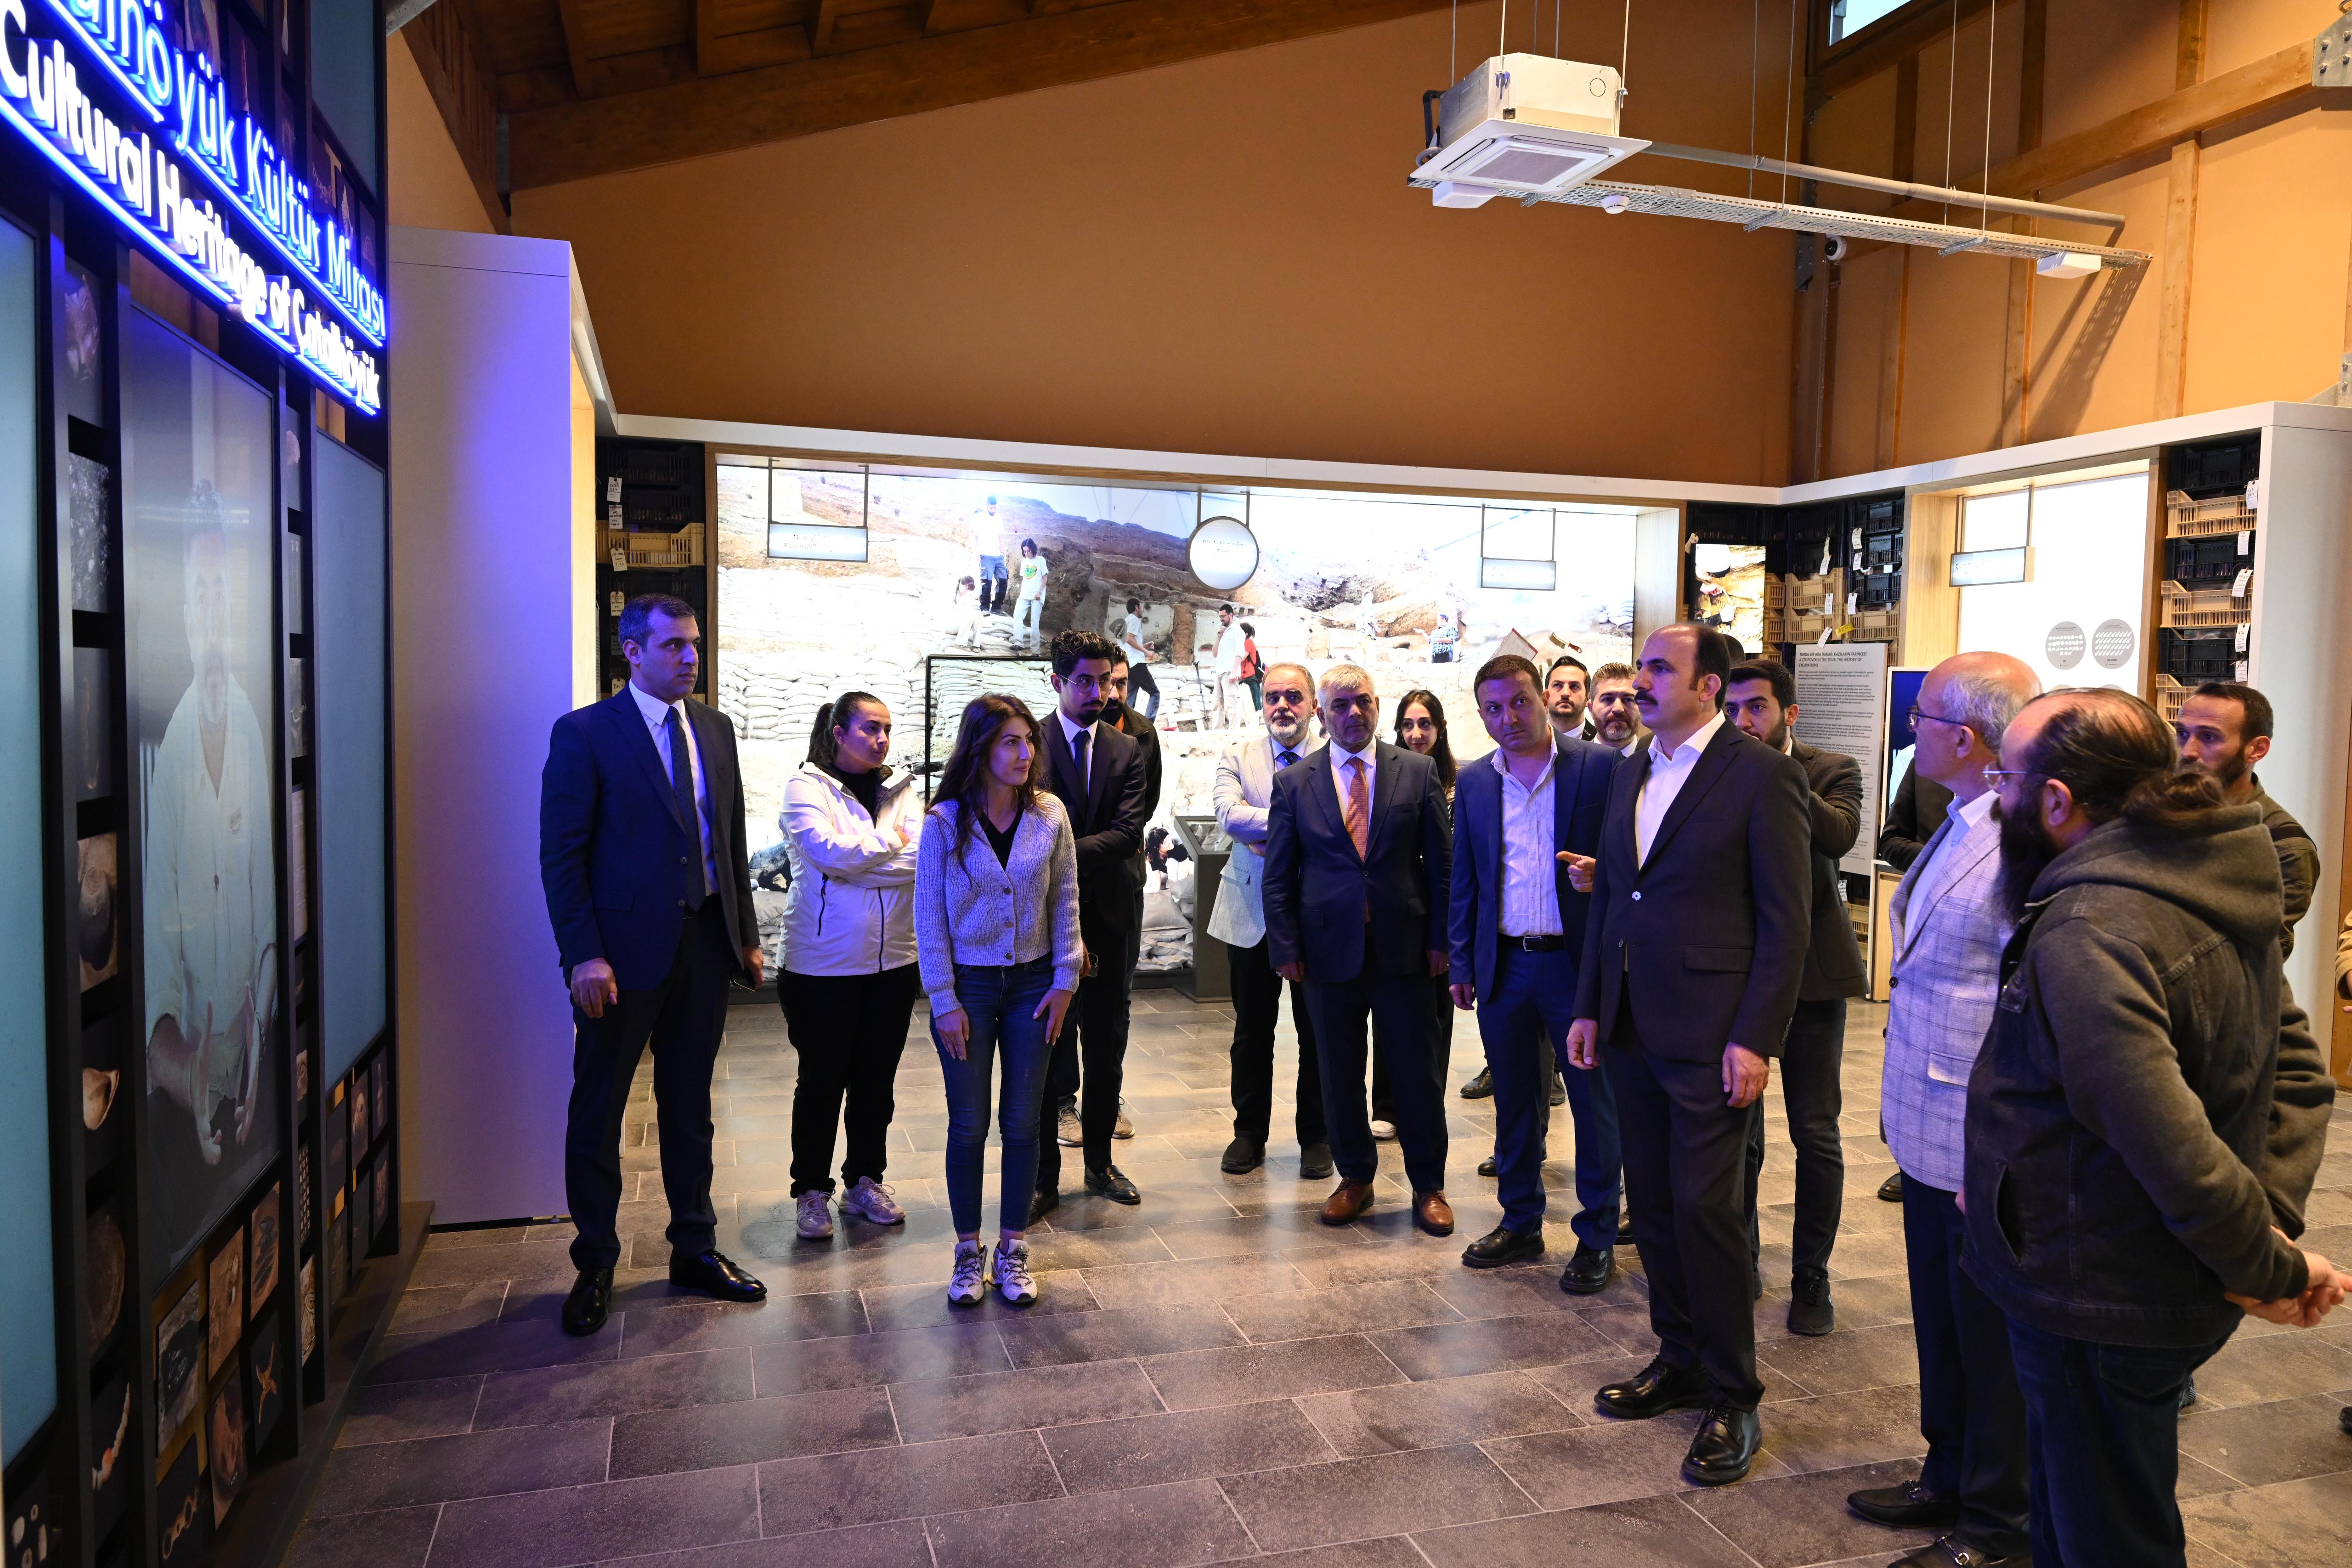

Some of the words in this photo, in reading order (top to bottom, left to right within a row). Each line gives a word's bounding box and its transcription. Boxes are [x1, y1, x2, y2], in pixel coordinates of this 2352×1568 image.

[0, 0, 151, 217] Cultural
[157, 150, 267, 322] Heritage
[270, 275, 290, 336] of
[246, 116, 320, 269] Kültür
[327, 218, 386, 340] Mirası
